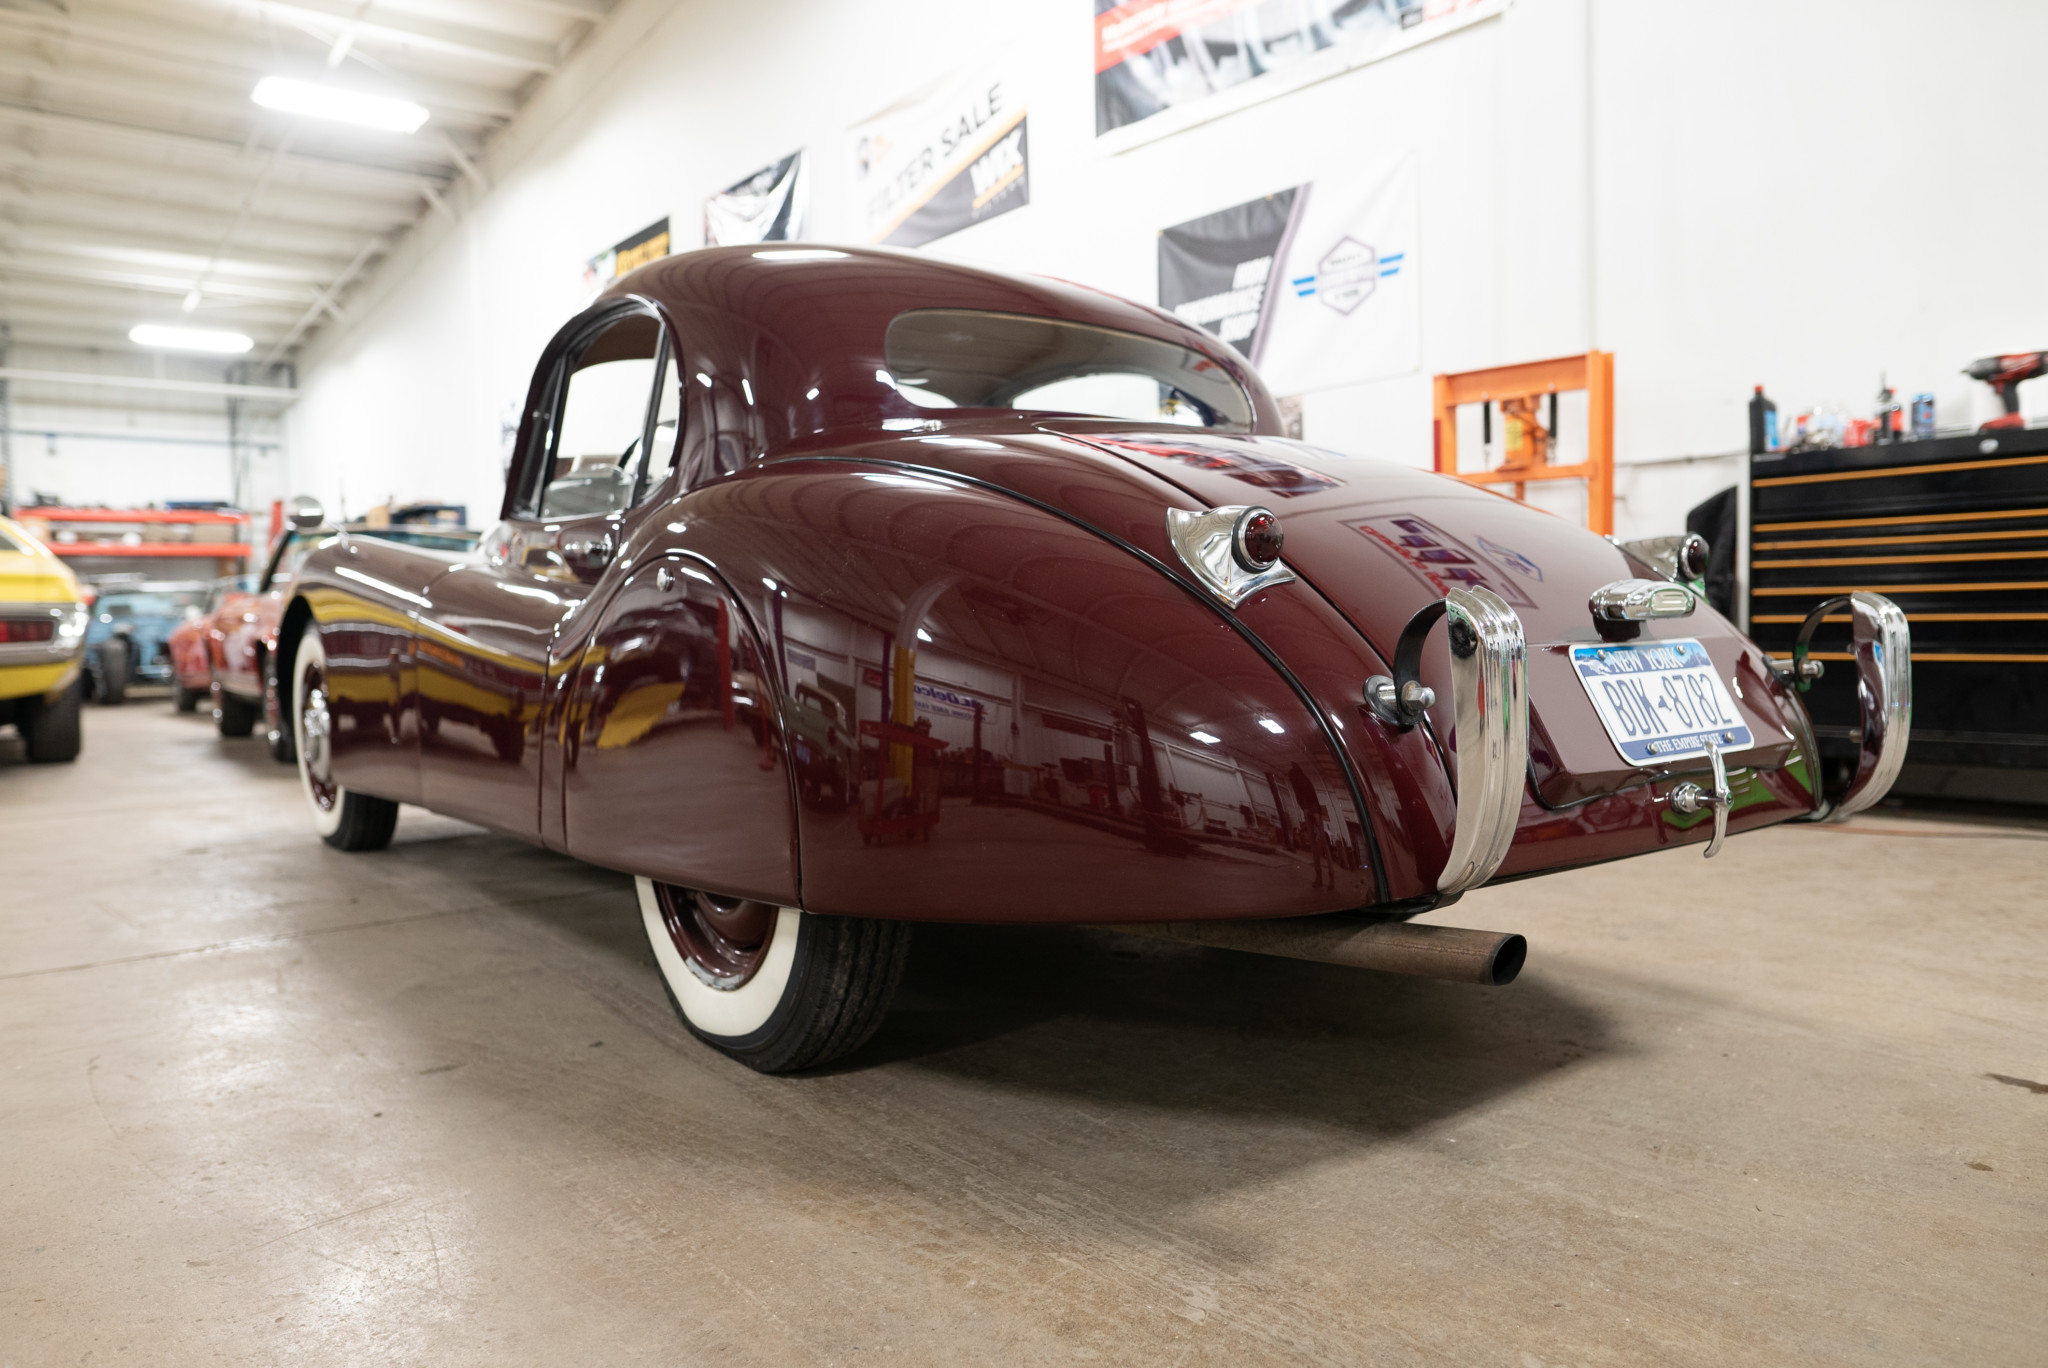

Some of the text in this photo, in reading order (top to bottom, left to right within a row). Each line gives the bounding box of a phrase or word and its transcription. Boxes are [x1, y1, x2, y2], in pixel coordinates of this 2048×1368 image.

[941, 82, 1001, 158] SALE
[970, 127, 1024, 197] WIX
[1608, 647, 1685, 673] NEW YORK
[1601, 673, 1733, 736] BDK 8782
[1654, 739, 1674, 753] THE
[1672, 736, 1703, 751] EMPIRE
